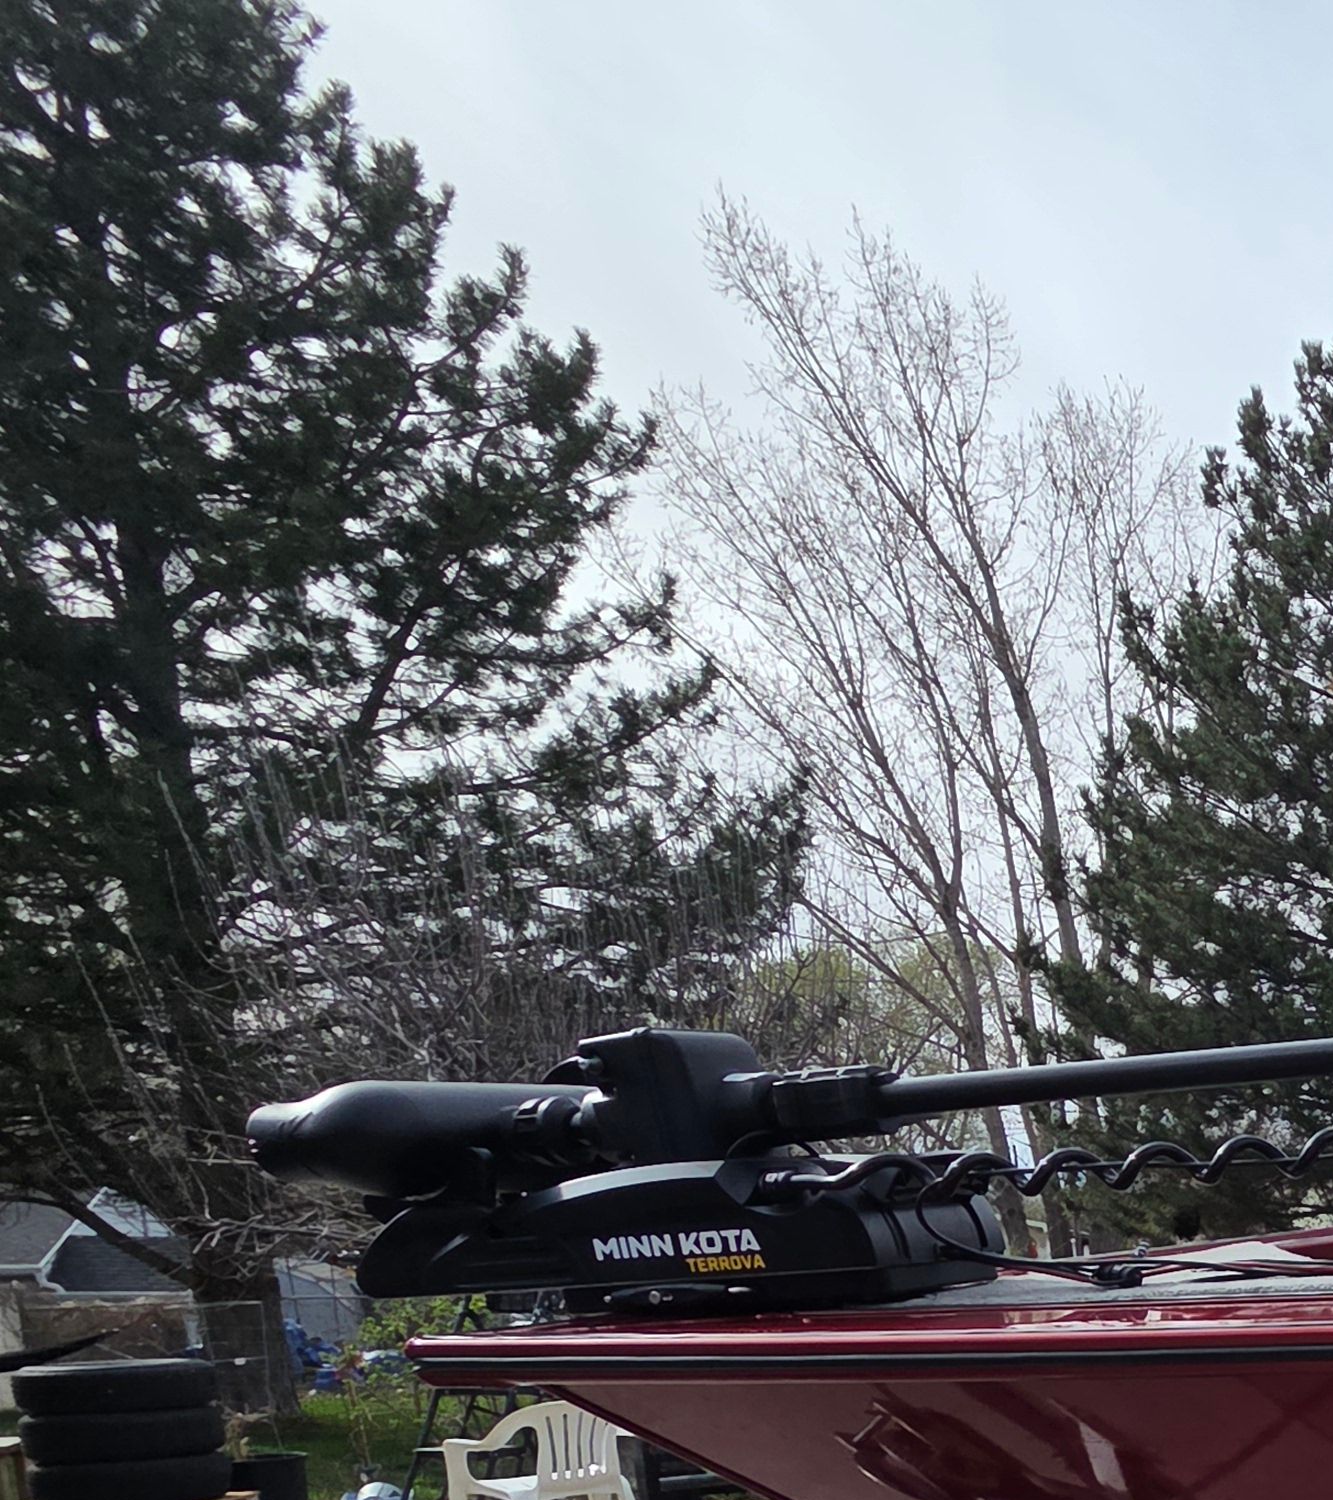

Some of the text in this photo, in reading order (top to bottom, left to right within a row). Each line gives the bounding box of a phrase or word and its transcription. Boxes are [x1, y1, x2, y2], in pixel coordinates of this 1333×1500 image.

[592, 1228, 761, 1261] MINN KOTA
[686, 1254, 766, 1273] TERROVA
